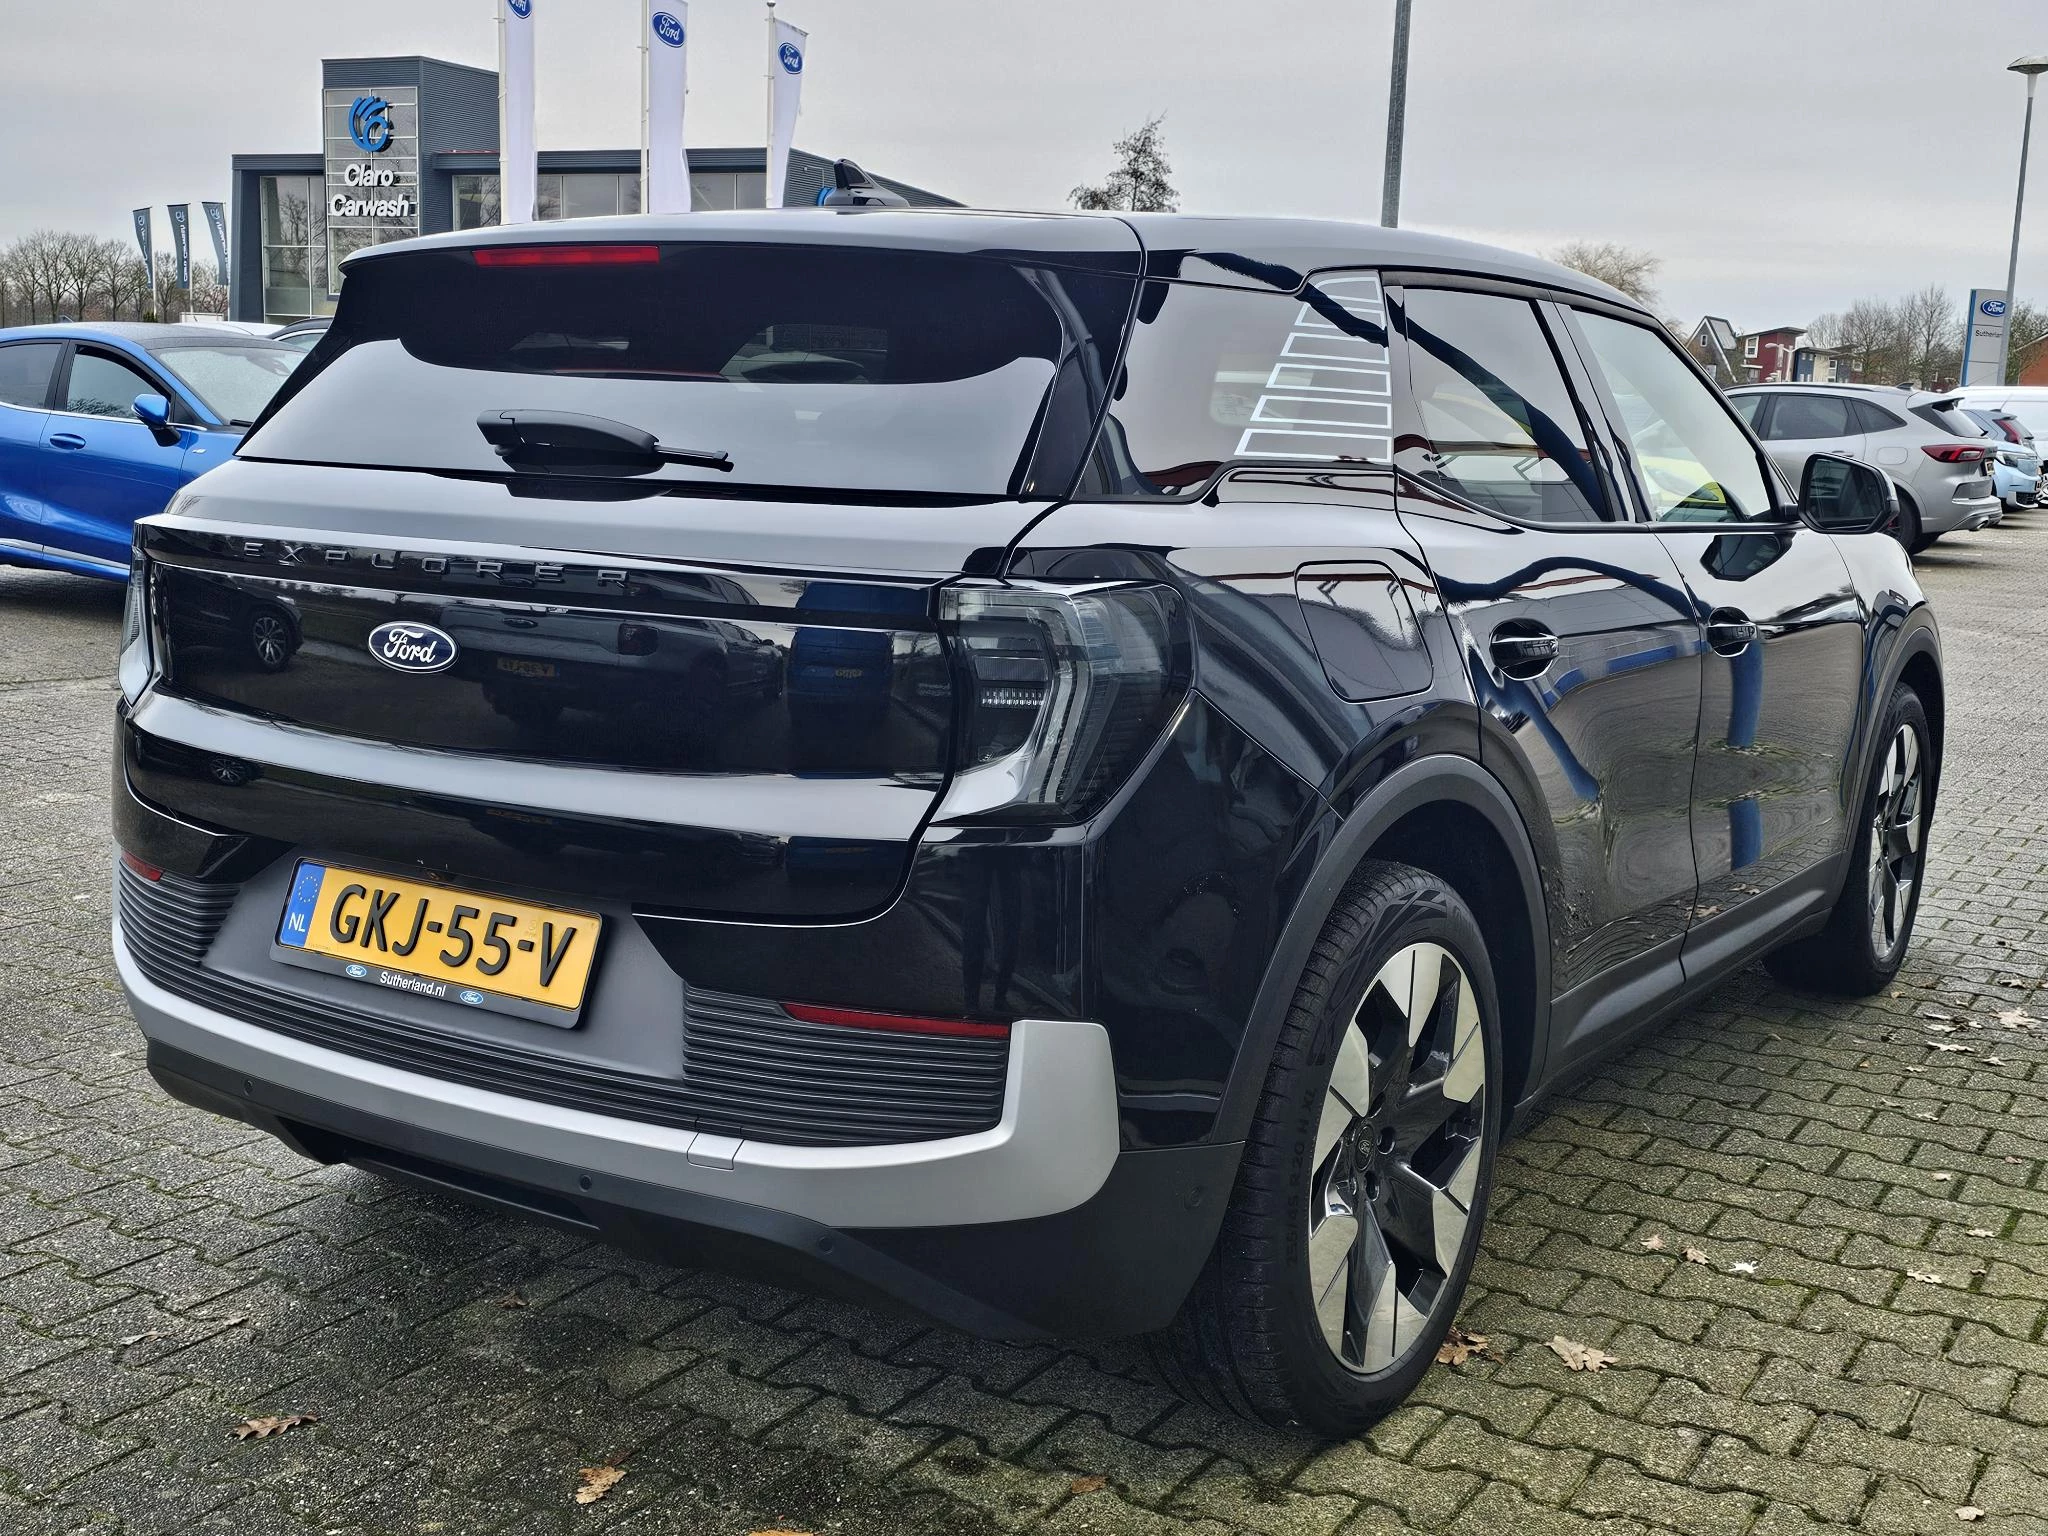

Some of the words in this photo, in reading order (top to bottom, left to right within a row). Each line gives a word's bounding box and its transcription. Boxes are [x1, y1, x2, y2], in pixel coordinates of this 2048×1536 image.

[659, 15, 681, 41] Ford
[783, 45, 799, 68] Ford
[344, 163, 394, 187] Claro
[329, 193, 409, 217] Carwash
[1987, 301, 2005, 313] Ford
[243, 542, 627, 589] EXPLORER
[383, 628, 437, 663] Ford
[288, 913, 306, 933] NL
[329, 884, 577, 988] GKJ-55-V
[380, 971, 447, 997] Sutherland.nl
